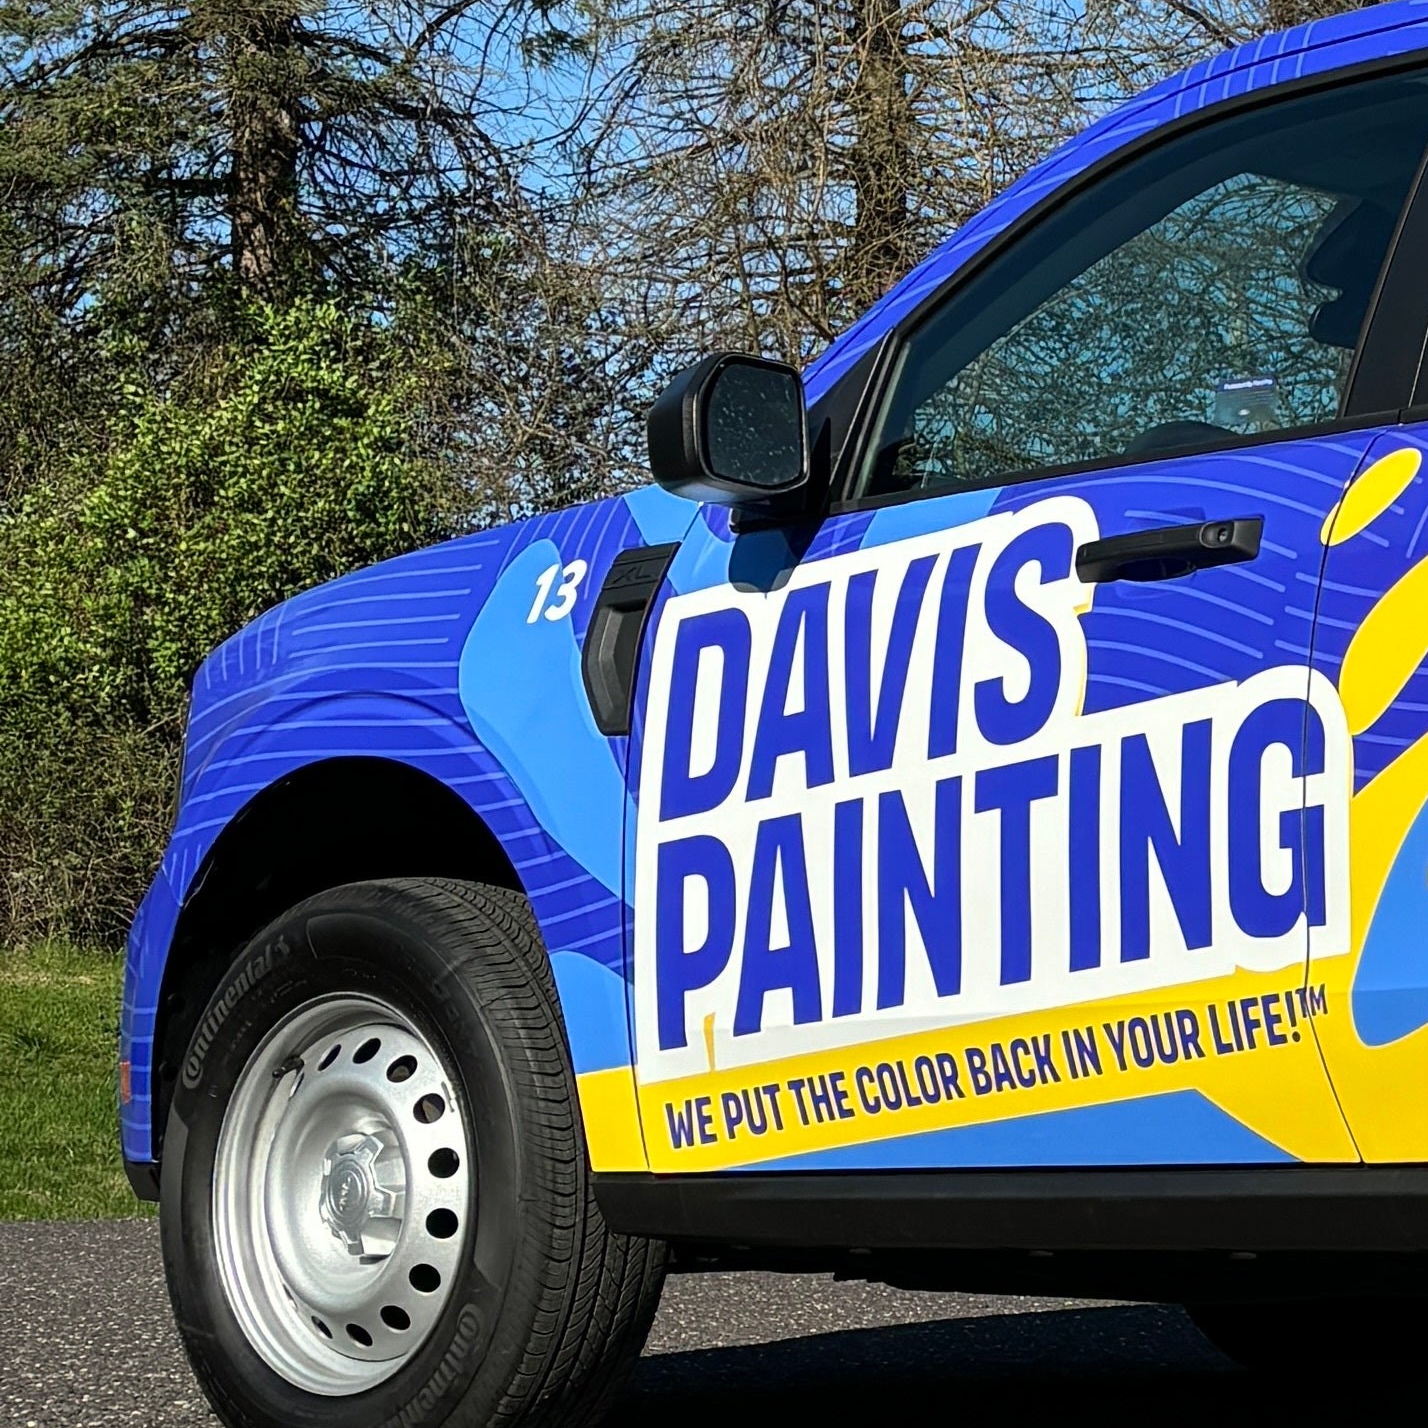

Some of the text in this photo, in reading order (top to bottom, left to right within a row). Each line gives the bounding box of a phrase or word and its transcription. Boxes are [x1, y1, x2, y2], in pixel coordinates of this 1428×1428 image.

[526, 559, 588, 624] 13
[659, 529, 1074, 822] DAVIS
[657, 695, 1326, 1050] PAINTING
[665, 1096, 717, 1149] WE
[721, 1083, 783, 1139] PUT
[787, 1071, 855, 1125] THE
[855, 1053, 965, 1114] COLOR
[965, 1033, 1061, 1096] BACK
[1062, 1026, 1103, 1079] IN
[1103, 1009, 1205, 1071] YOUR
